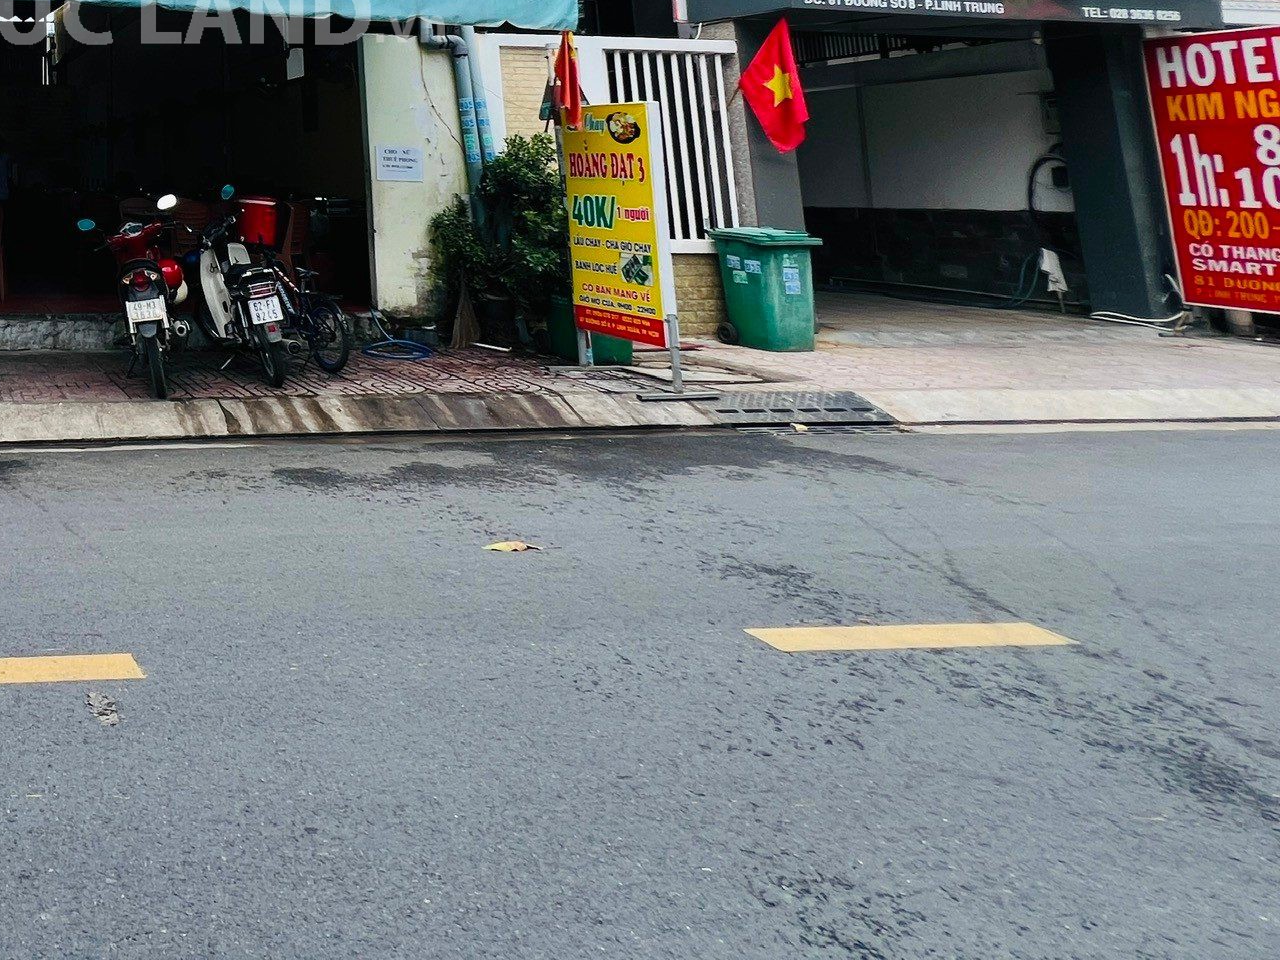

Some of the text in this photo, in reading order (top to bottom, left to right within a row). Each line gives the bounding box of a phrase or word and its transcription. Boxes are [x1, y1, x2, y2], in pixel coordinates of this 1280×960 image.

[964, 1, 1005, 14] TRUNG
[1166, 92, 1225, 122] KIM
[569, 140, 645, 186] HOÀNG ĐẠT 3
[572, 195, 615, 229] 40K/
[624, 206, 650, 221] người
[1226, 210, 1270, 240] 200
[633, 243, 652, 254] CHAY
[1188, 240, 1214, 258] CÓ
[1192, 257, 1278, 277] SMART
[613, 288, 638, 300] MANG
